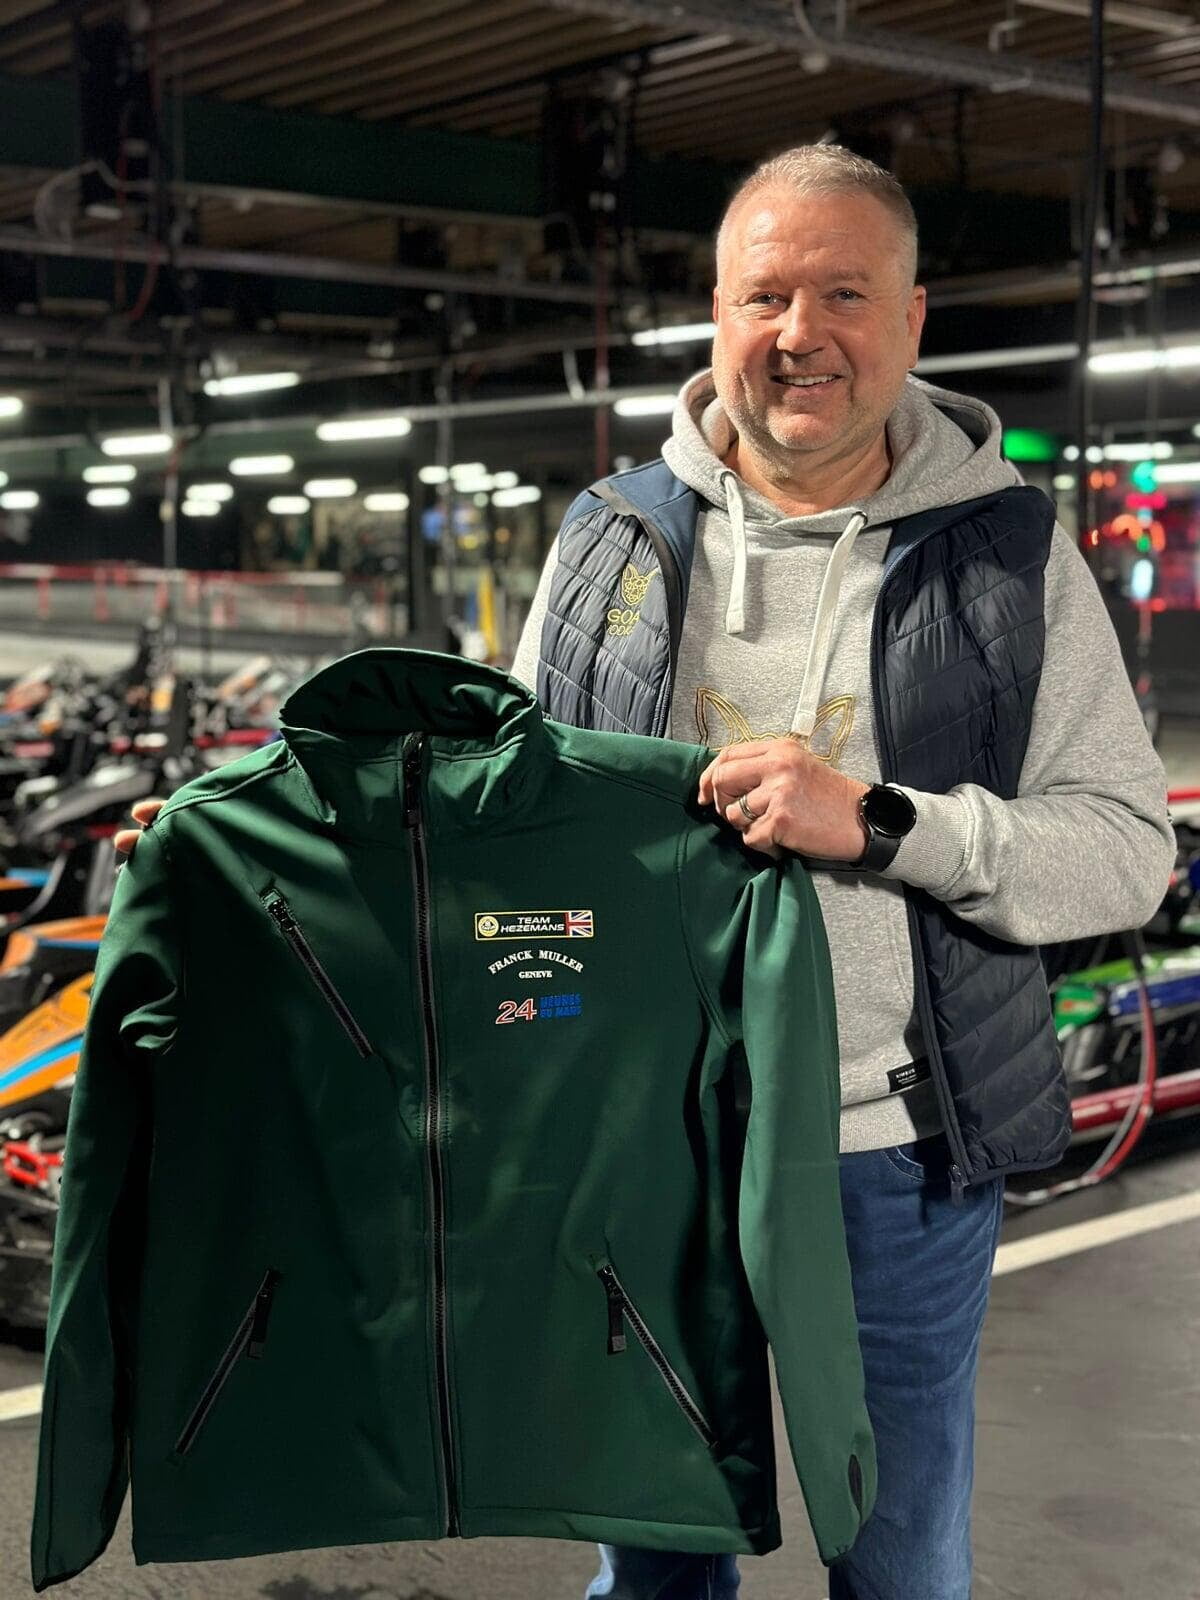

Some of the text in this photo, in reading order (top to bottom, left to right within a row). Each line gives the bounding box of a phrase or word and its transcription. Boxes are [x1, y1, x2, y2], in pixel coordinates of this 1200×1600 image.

[517, 916, 551, 924] TEAM
[500, 923, 565, 933] HEZEMANS
[487, 950, 584, 975] FRANCK MULLER
[518, 970, 553, 979] GENEVE
[495, 998, 538, 1025] 24
